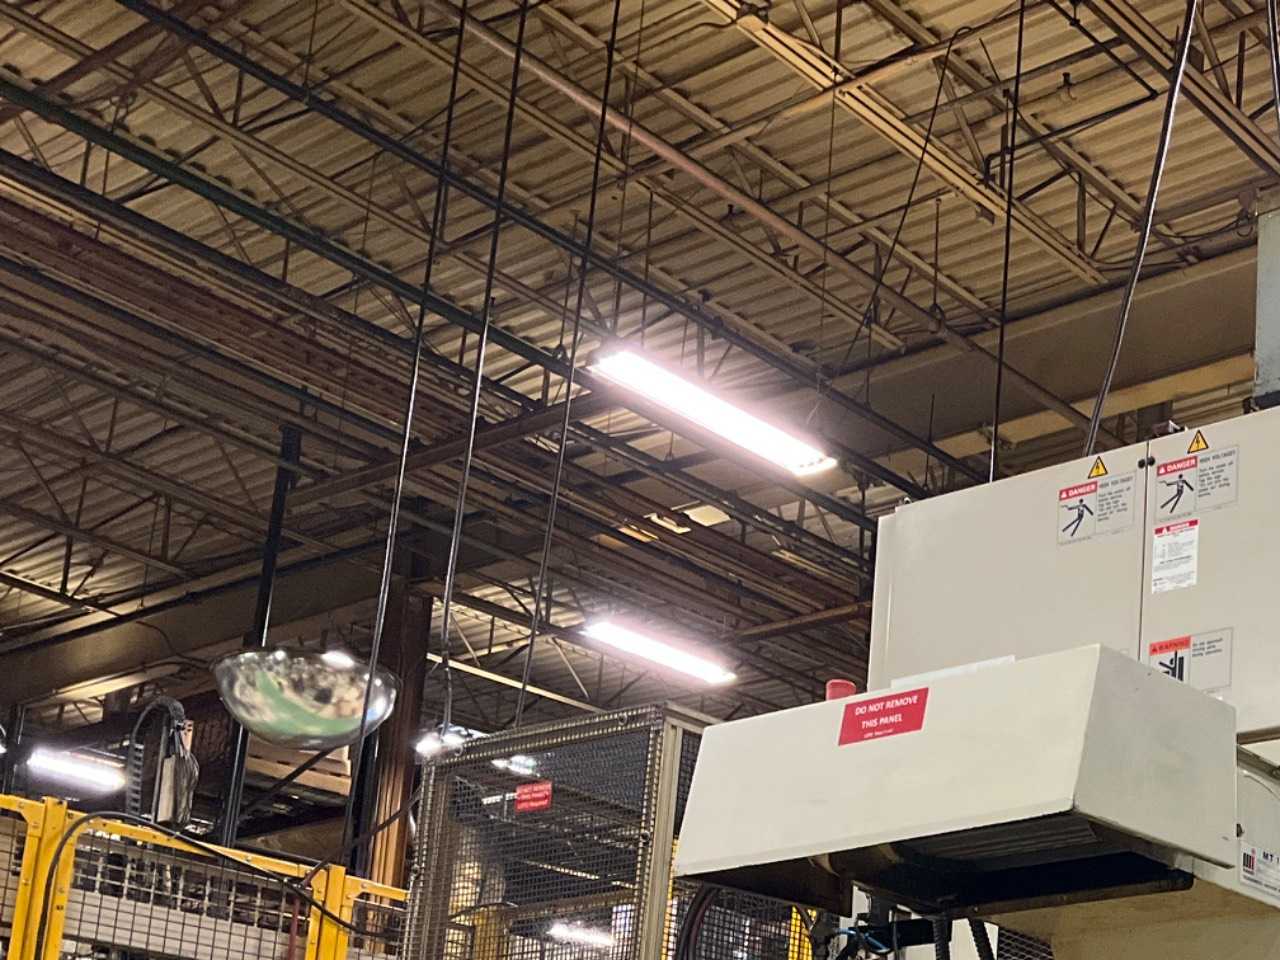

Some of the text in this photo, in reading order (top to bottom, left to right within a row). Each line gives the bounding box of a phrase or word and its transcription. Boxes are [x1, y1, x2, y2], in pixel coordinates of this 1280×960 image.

[1166, 458, 1196, 473] DANGER
[1068, 483, 1096, 497] DANGER
[855, 695, 918, 716] DO NOT REMOVE
[861, 713, 902, 729] THIS PANEL
[1263, 851, 1273, 862] MT
